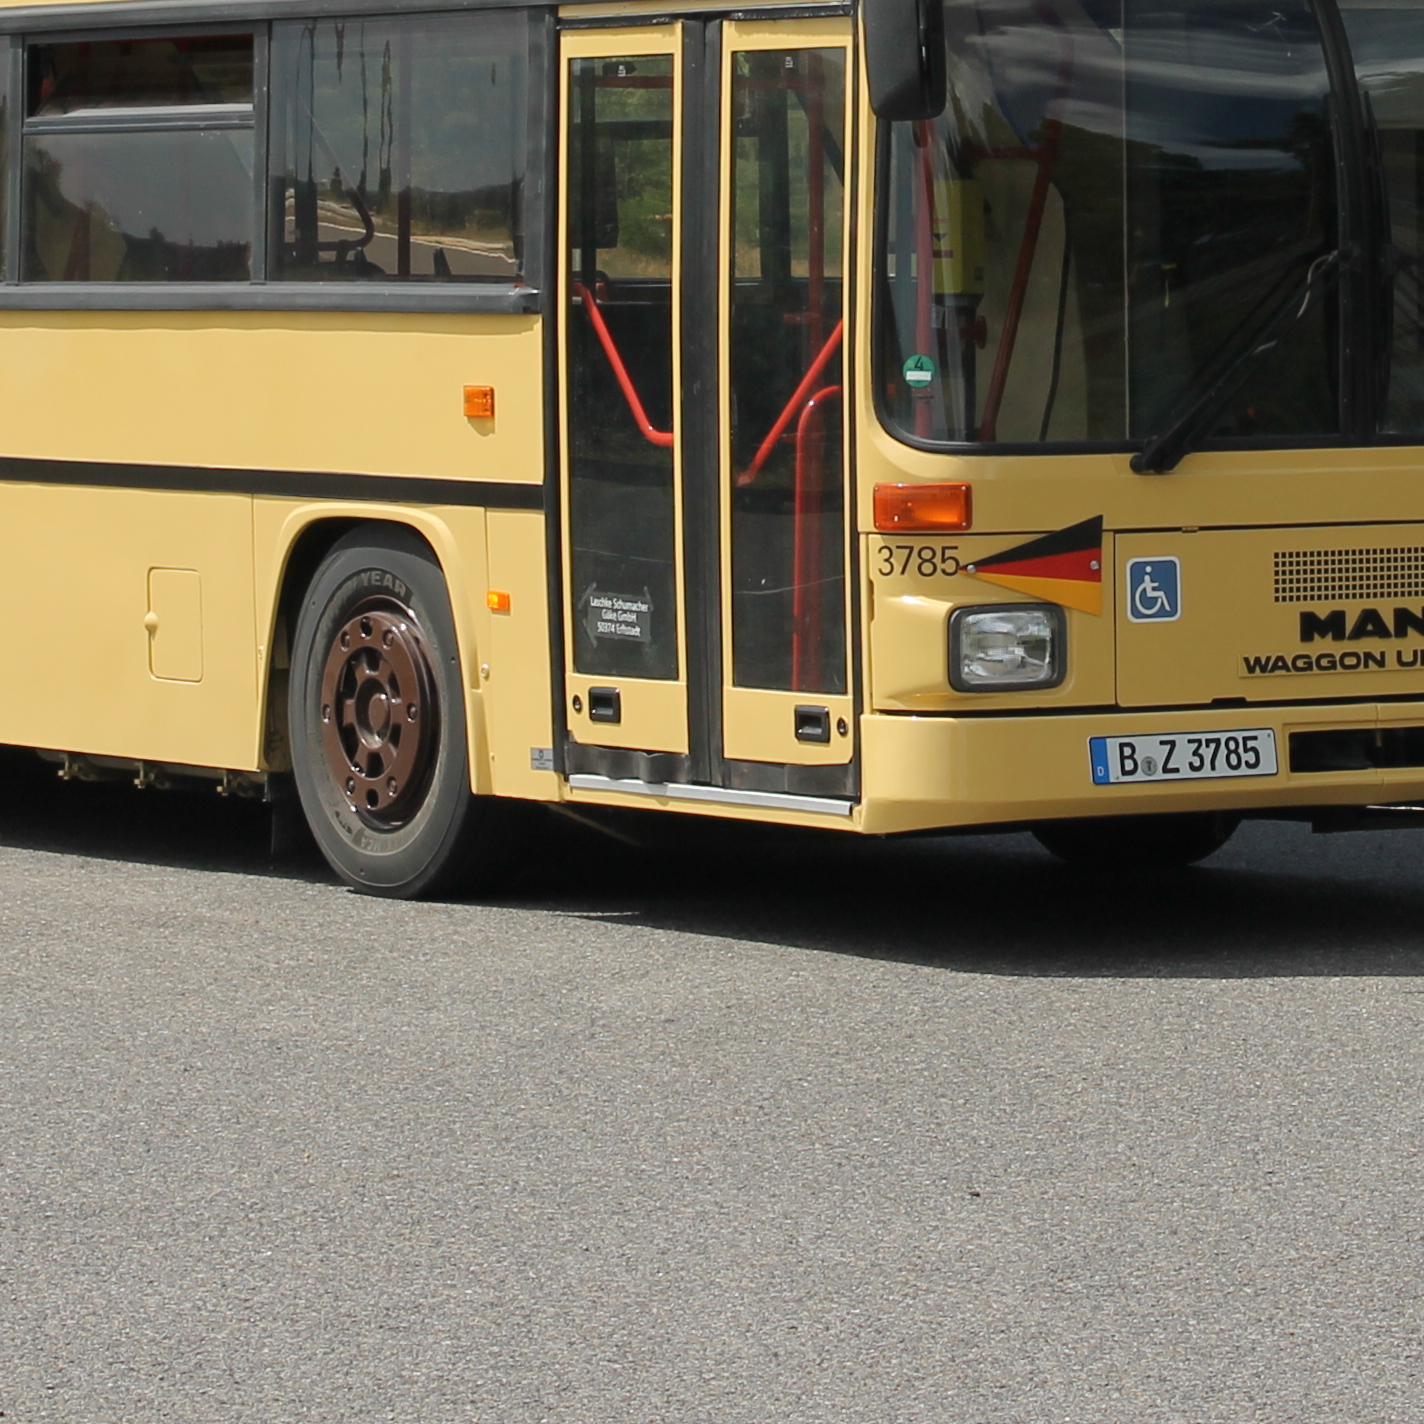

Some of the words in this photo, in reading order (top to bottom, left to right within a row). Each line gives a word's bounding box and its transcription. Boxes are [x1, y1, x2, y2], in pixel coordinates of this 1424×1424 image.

[914, 356, 924, 371] 4
[877, 545, 960, 577] 3785
[1243, 650, 1386, 674] WAGGON
[1118, 742, 1139, 777] B
[1159, 739, 1180, 774] Z
[1187, 735, 1261, 773] 3785
[1097, 766, 1104, 777] D
